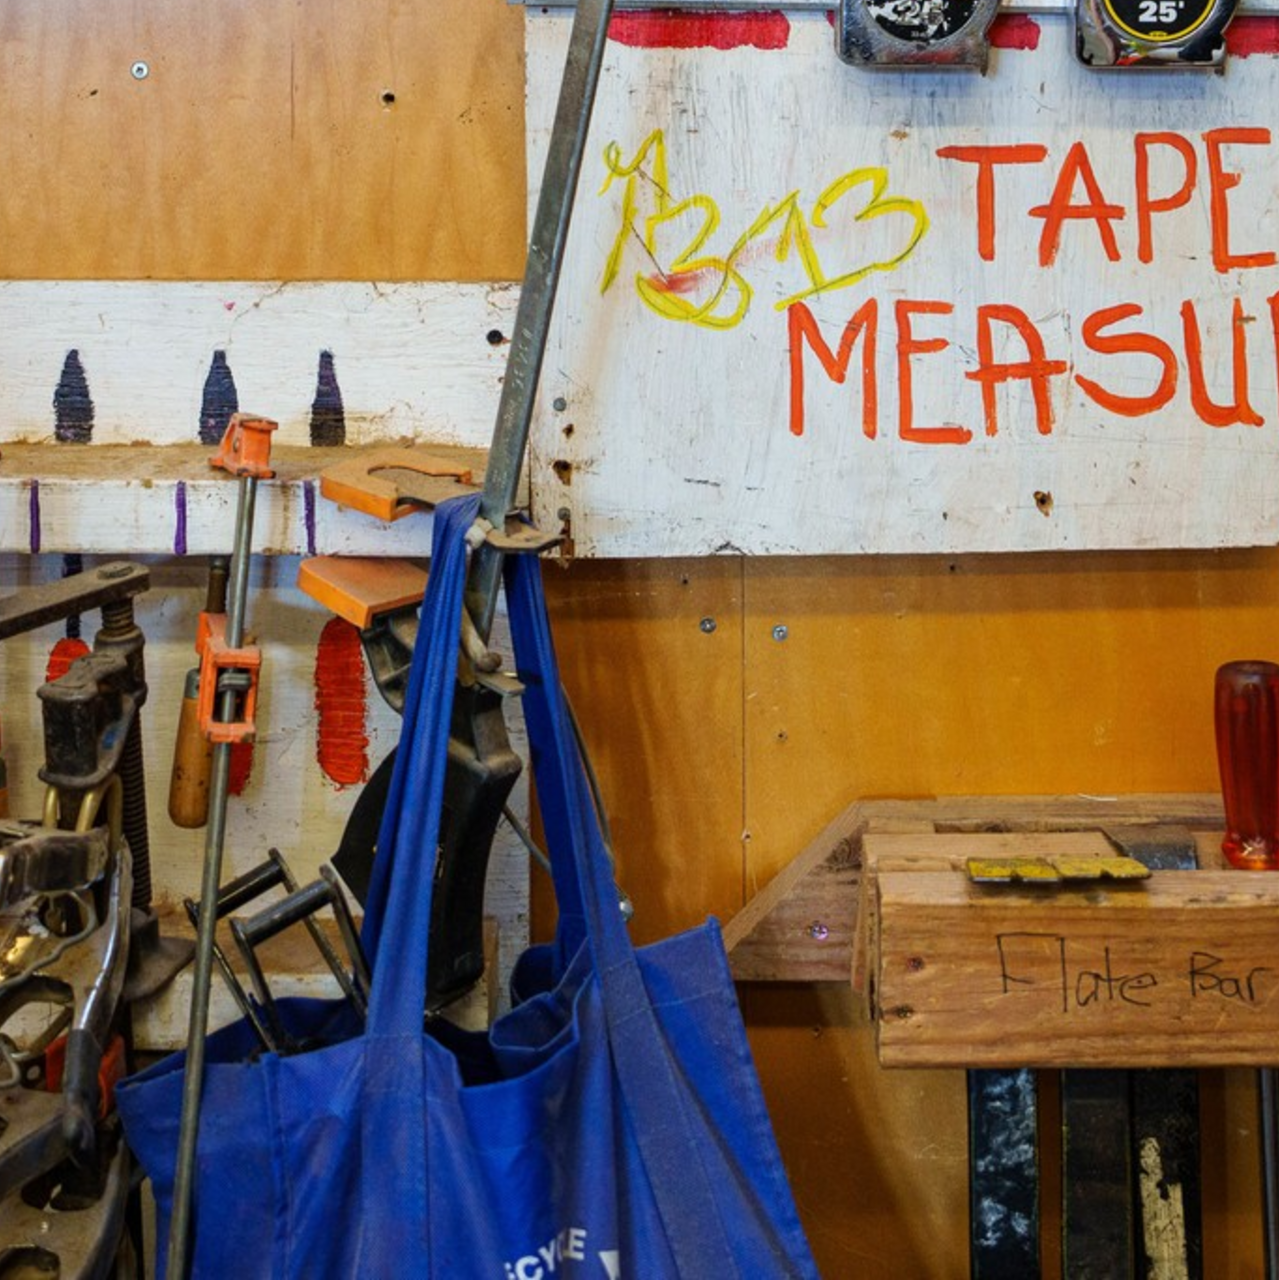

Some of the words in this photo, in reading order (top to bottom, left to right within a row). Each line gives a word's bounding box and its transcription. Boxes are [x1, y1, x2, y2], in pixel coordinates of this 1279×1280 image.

[1138, 0, 1184, 23] 25'
[936, 126, 1279, 274] TAPE
[1188, 951, 1273, 1002] Bar
